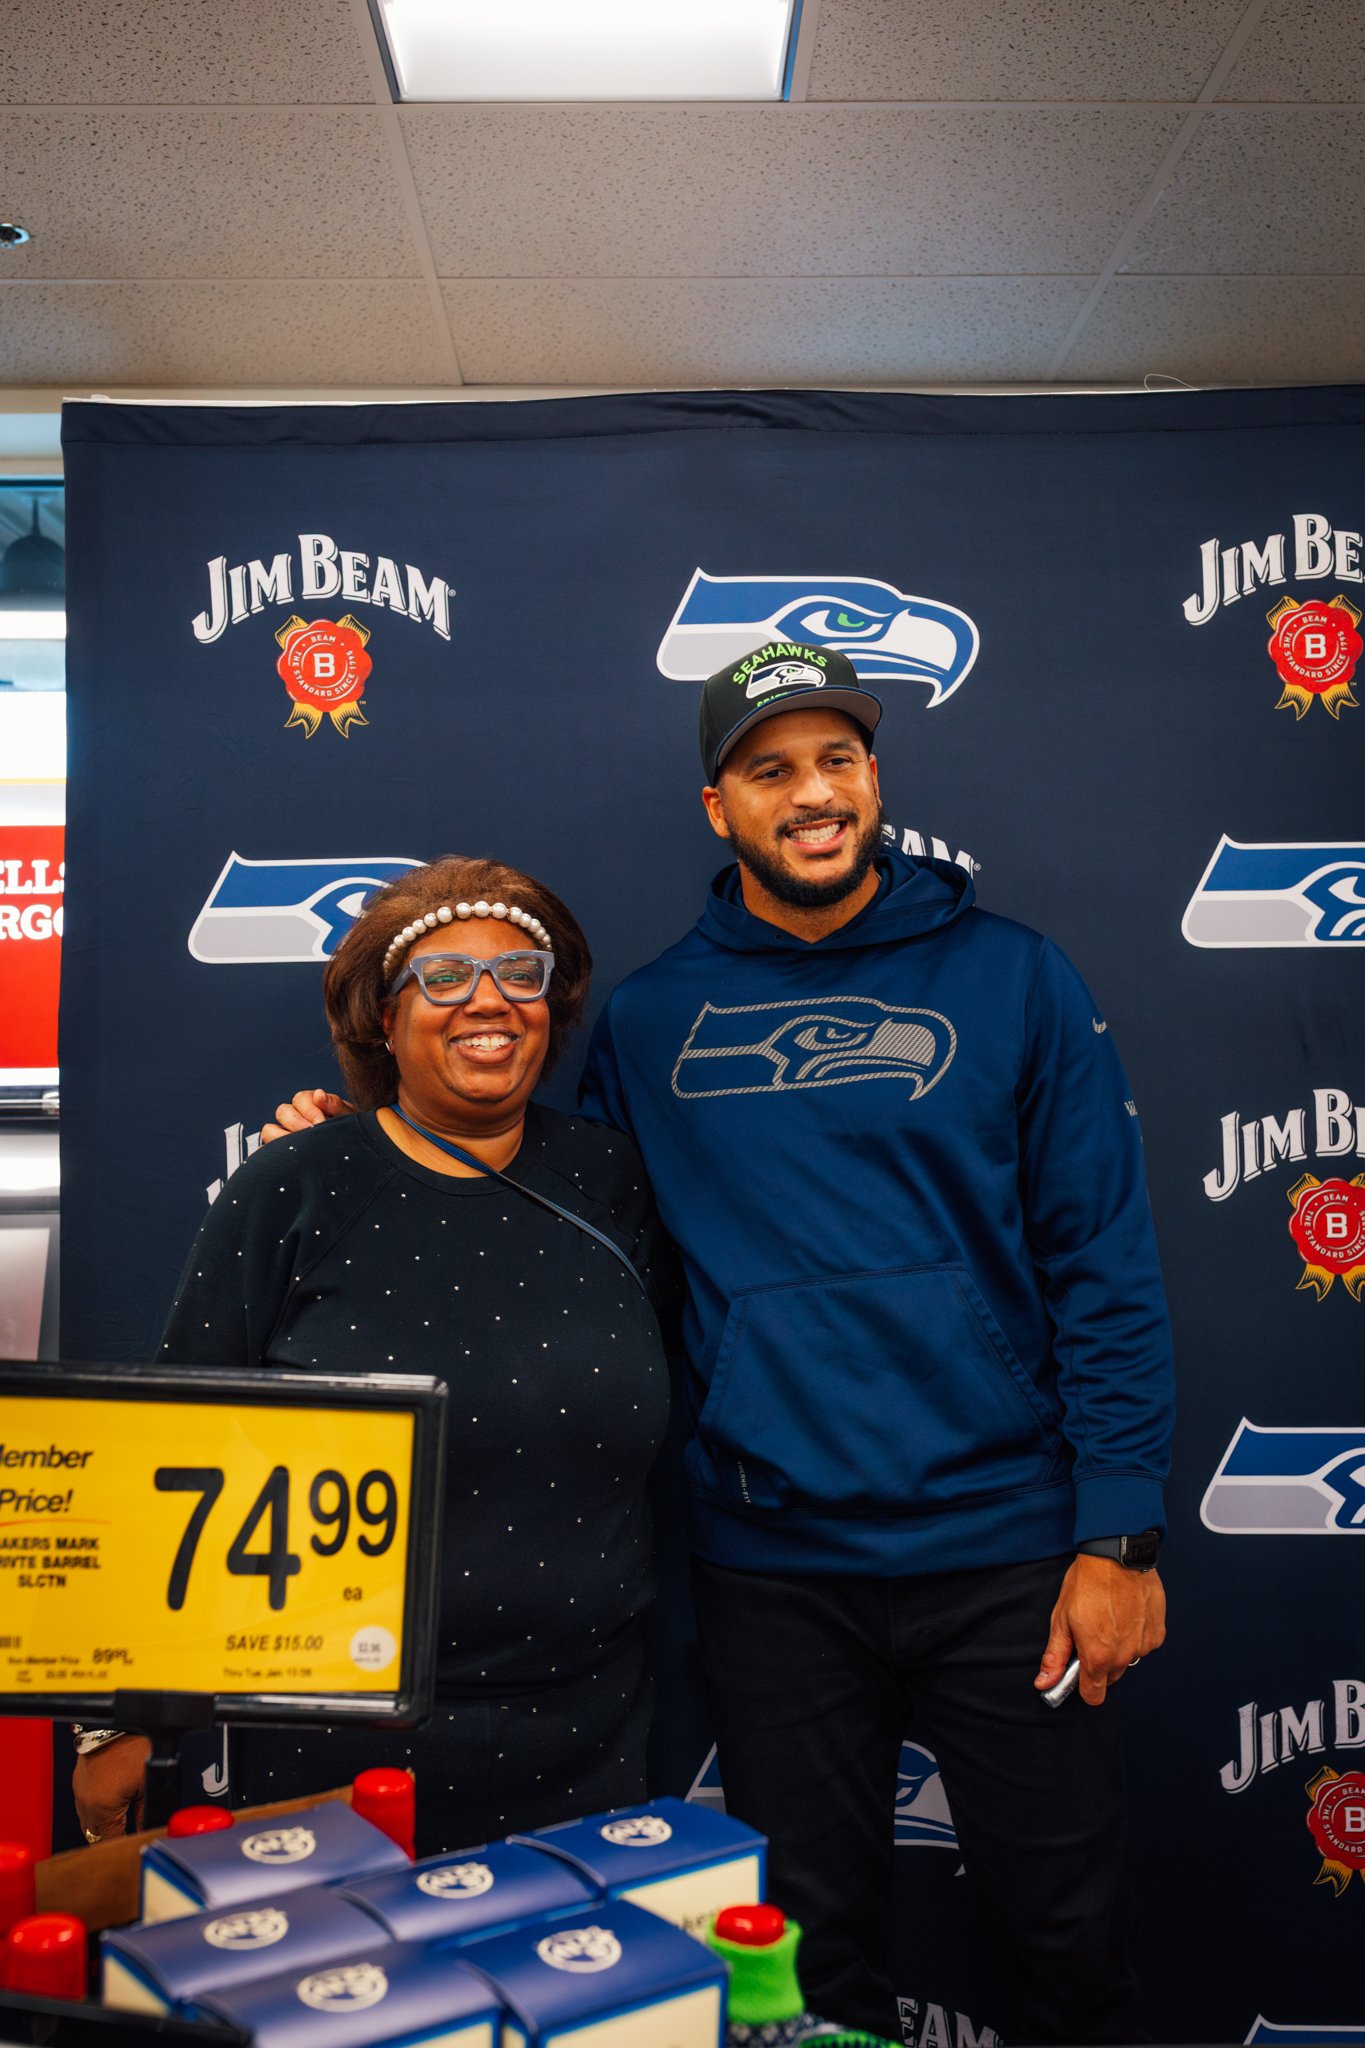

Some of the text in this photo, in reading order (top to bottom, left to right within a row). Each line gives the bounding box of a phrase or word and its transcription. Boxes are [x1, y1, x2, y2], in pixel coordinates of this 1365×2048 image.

[1182, 533, 1287, 626] JIM
[191, 553, 295, 644] JIM
[1302, 615, 1327, 624] BEAM
[310, 634, 336, 643] BEAM
[1283, 632, 1293, 648] THE
[1304, 633, 1327, 659] B
[292, 651, 302, 667] THE
[313, 652, 336, 678] B
[732, 642, 828, 685] SEAHAWKS
[1284, 651, 1323, 678] STANDARD
[1325, 653, 1346, 676] SINCE
[293, 670, 332, 697] STANDARD
[334, 673, 355, 694] SINCE
[1202, 1108, 1308, 1203] JIM
[1323, 1193, 1348, 1202] BEAM
[1304, 1210, 1314, 1227] THE
[1325, 1212, 1348, 1238] B
[1305, 1230, 1344, 1258] STANDARD
[56, 1537, 99, 1550] MARK
[42, 1556, 101, 1569] BARREL
[18, 1574, 67, 1588] SLCTN
[343, 1587, 362, 1601] ea
[226, 1634, 324, 1651] SAVE $15.00
[1219, 1699, 1326, 1794] JIM
[1322, 1804, 1363, 1853] THE STANDARD
[1344, 1806, 1365, 1832] B
